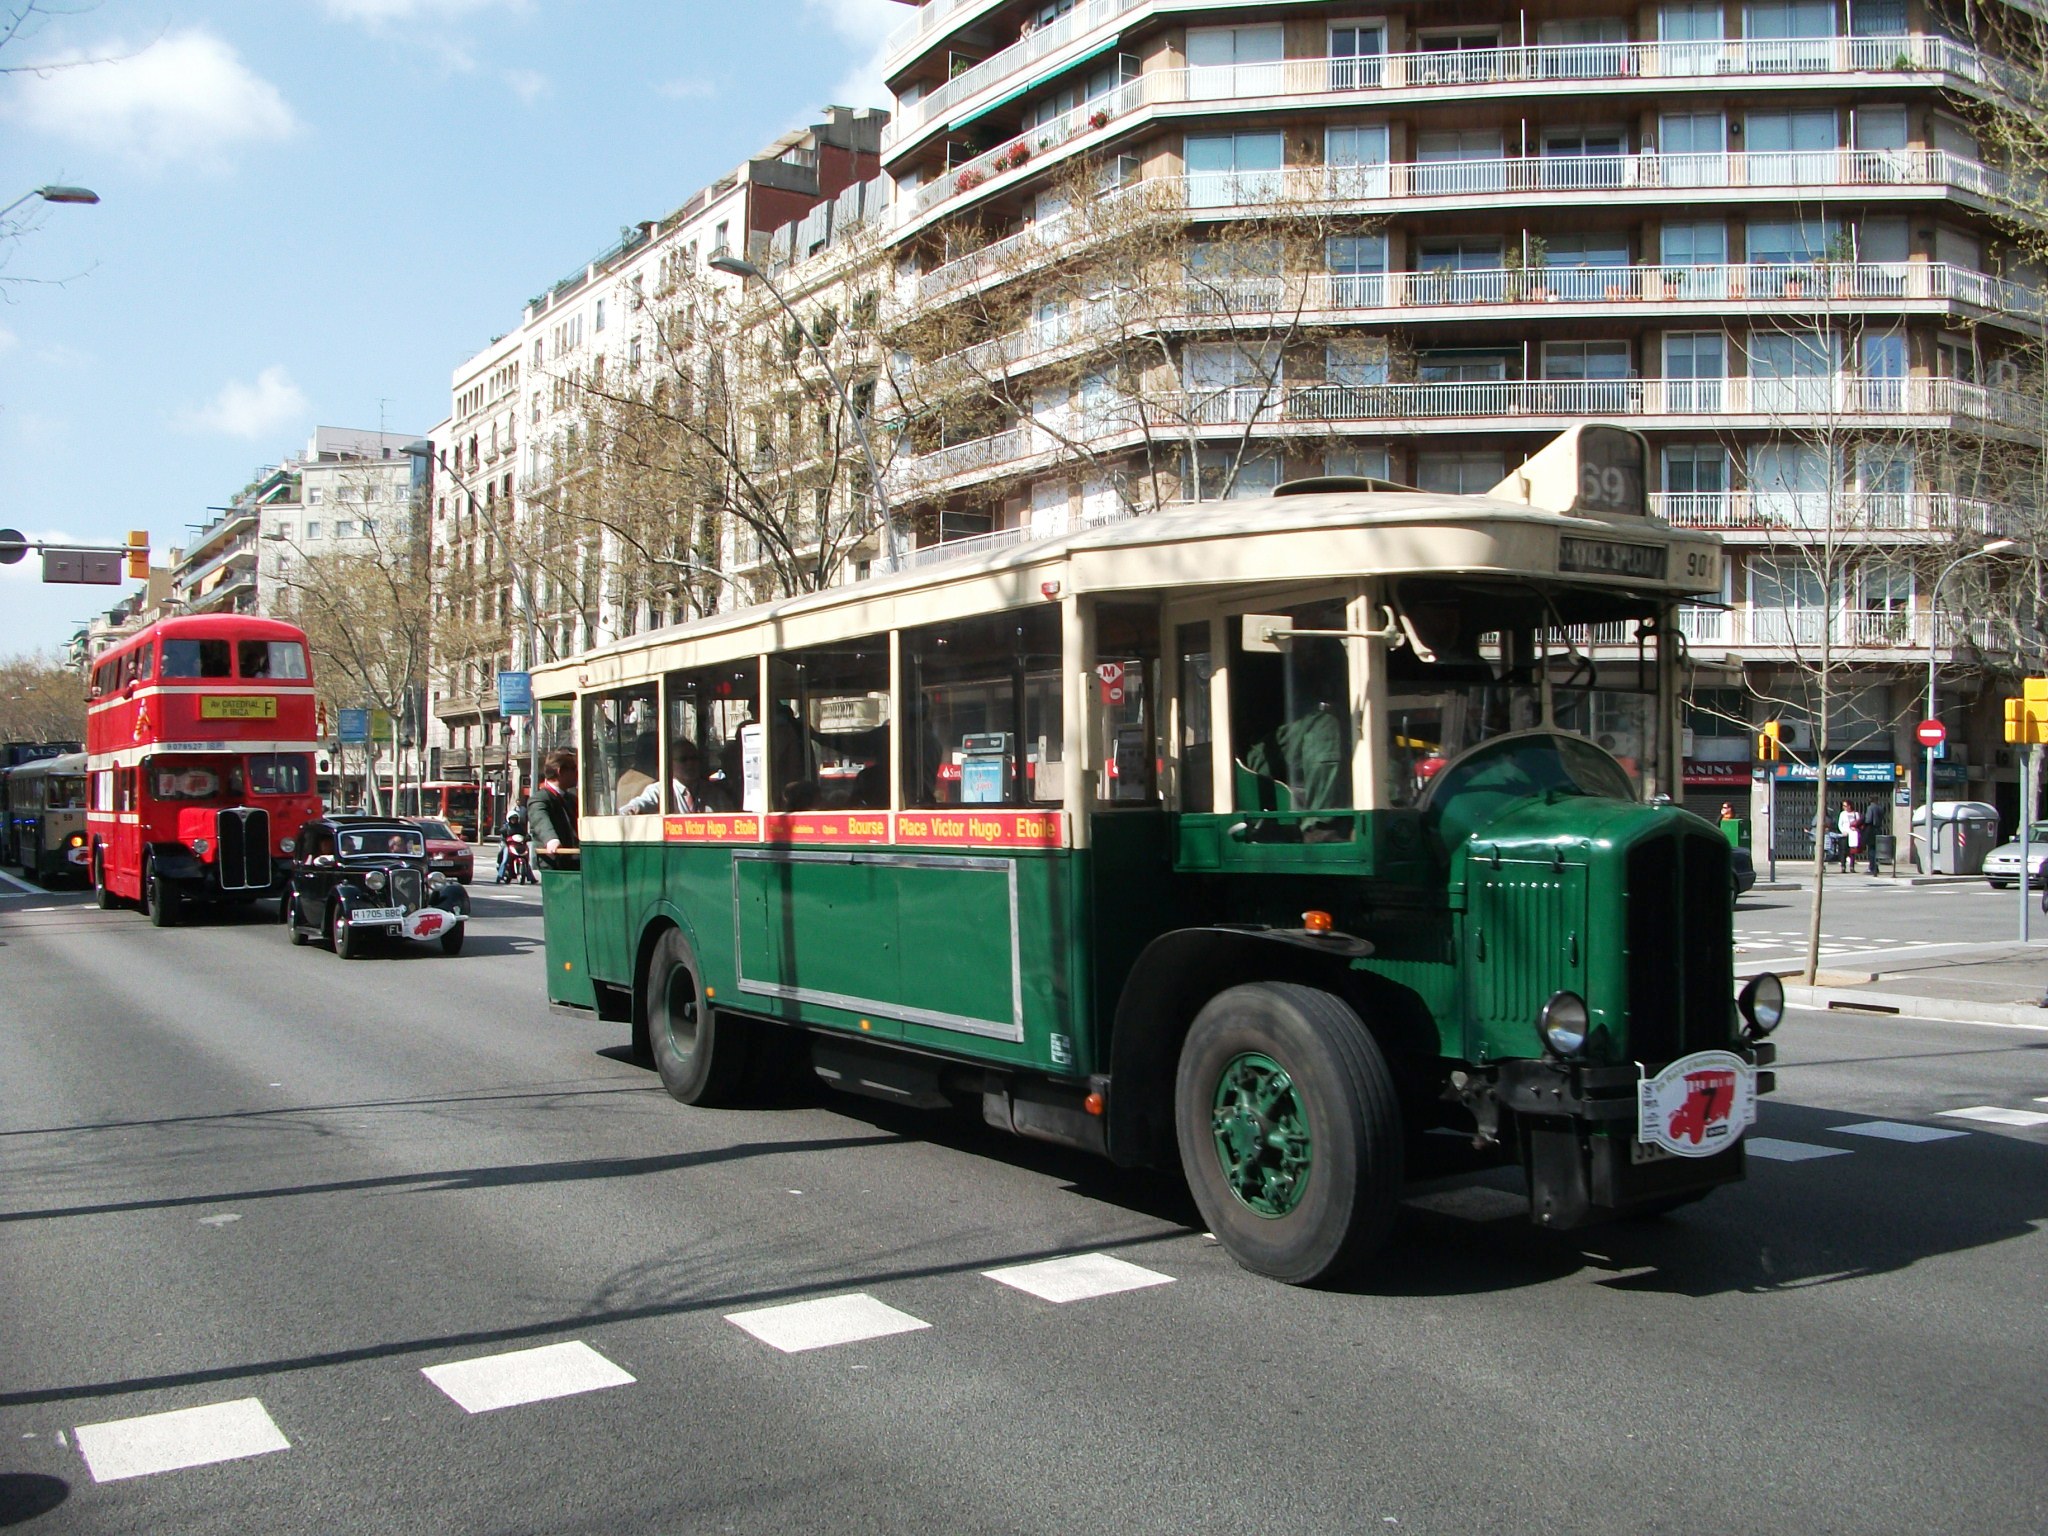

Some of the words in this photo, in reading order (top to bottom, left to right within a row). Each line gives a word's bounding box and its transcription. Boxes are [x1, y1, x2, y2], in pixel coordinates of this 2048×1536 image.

[1580, 461, 1625, 508] 69
[1687, 552, 1714, 579] 901
[1102, 665, 1116, 678] M
[264, 701, 272, 716] F
[26, 748, 68, 757] ALSA
[665, 821, 683, 835] Place
[685, 820, 705, 835] Victor
[707, 820, 727, 838] Hugo
[734, 819, 757, 835] Etoile
[848, 817, 884, 835] Bourse
[899, 818, 928, 837] Place
[931, 817, 964, 837] Victor
[969, 818, 1001, 842] Hugo
[1016, 817, 1056, 838] Etoile
[362, 910, 381, 918] 1705
[1700, 1087, 1717, 1121] 7
